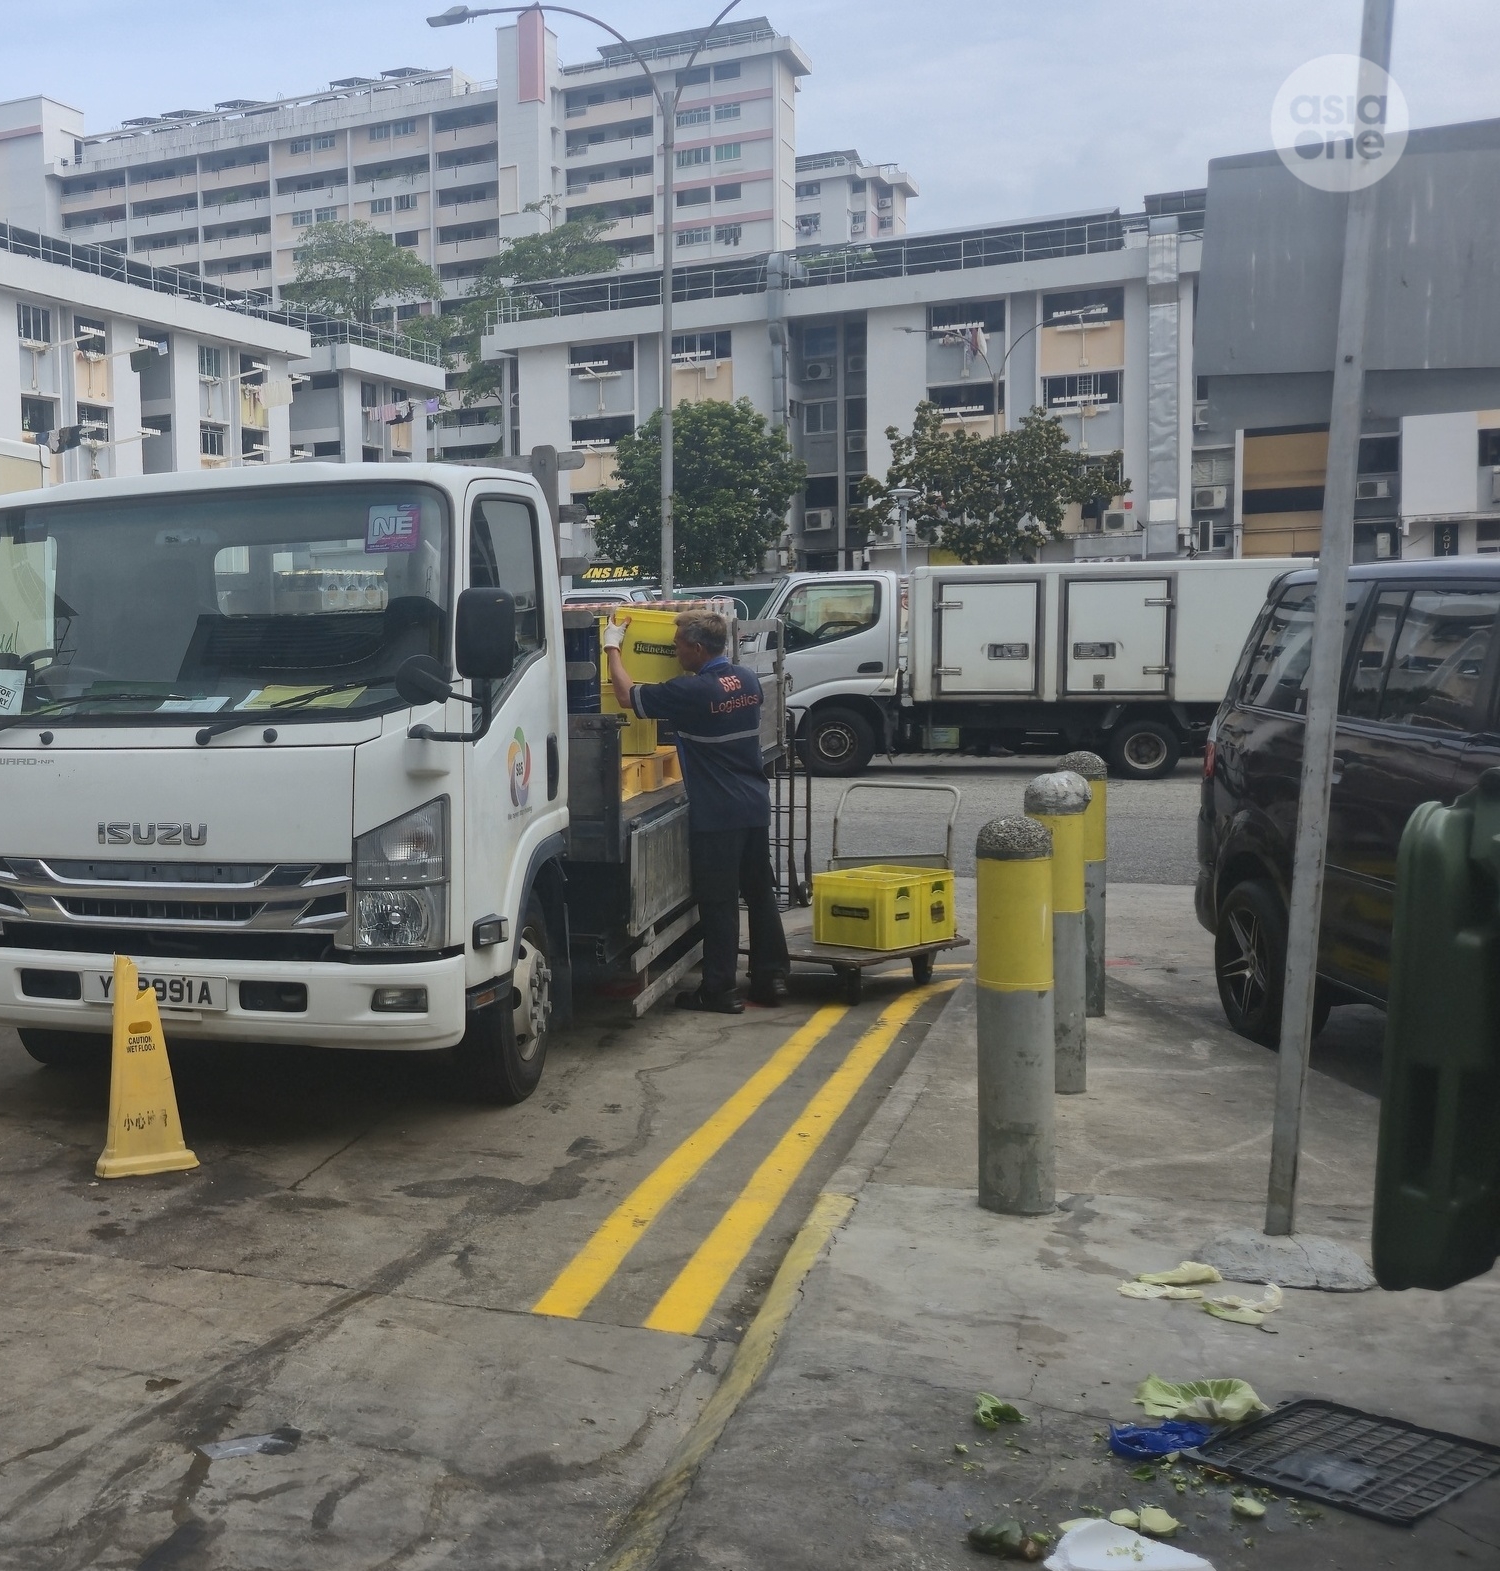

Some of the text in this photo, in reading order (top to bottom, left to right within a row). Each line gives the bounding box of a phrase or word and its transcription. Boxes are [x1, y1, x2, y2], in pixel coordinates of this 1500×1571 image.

[372, 516, 413, 536] NE
[711, 694, 758, 713] Logistics
[97, 821, 208, 846] ISUZU
[128, 1035, 153, 1045] CAUTION
